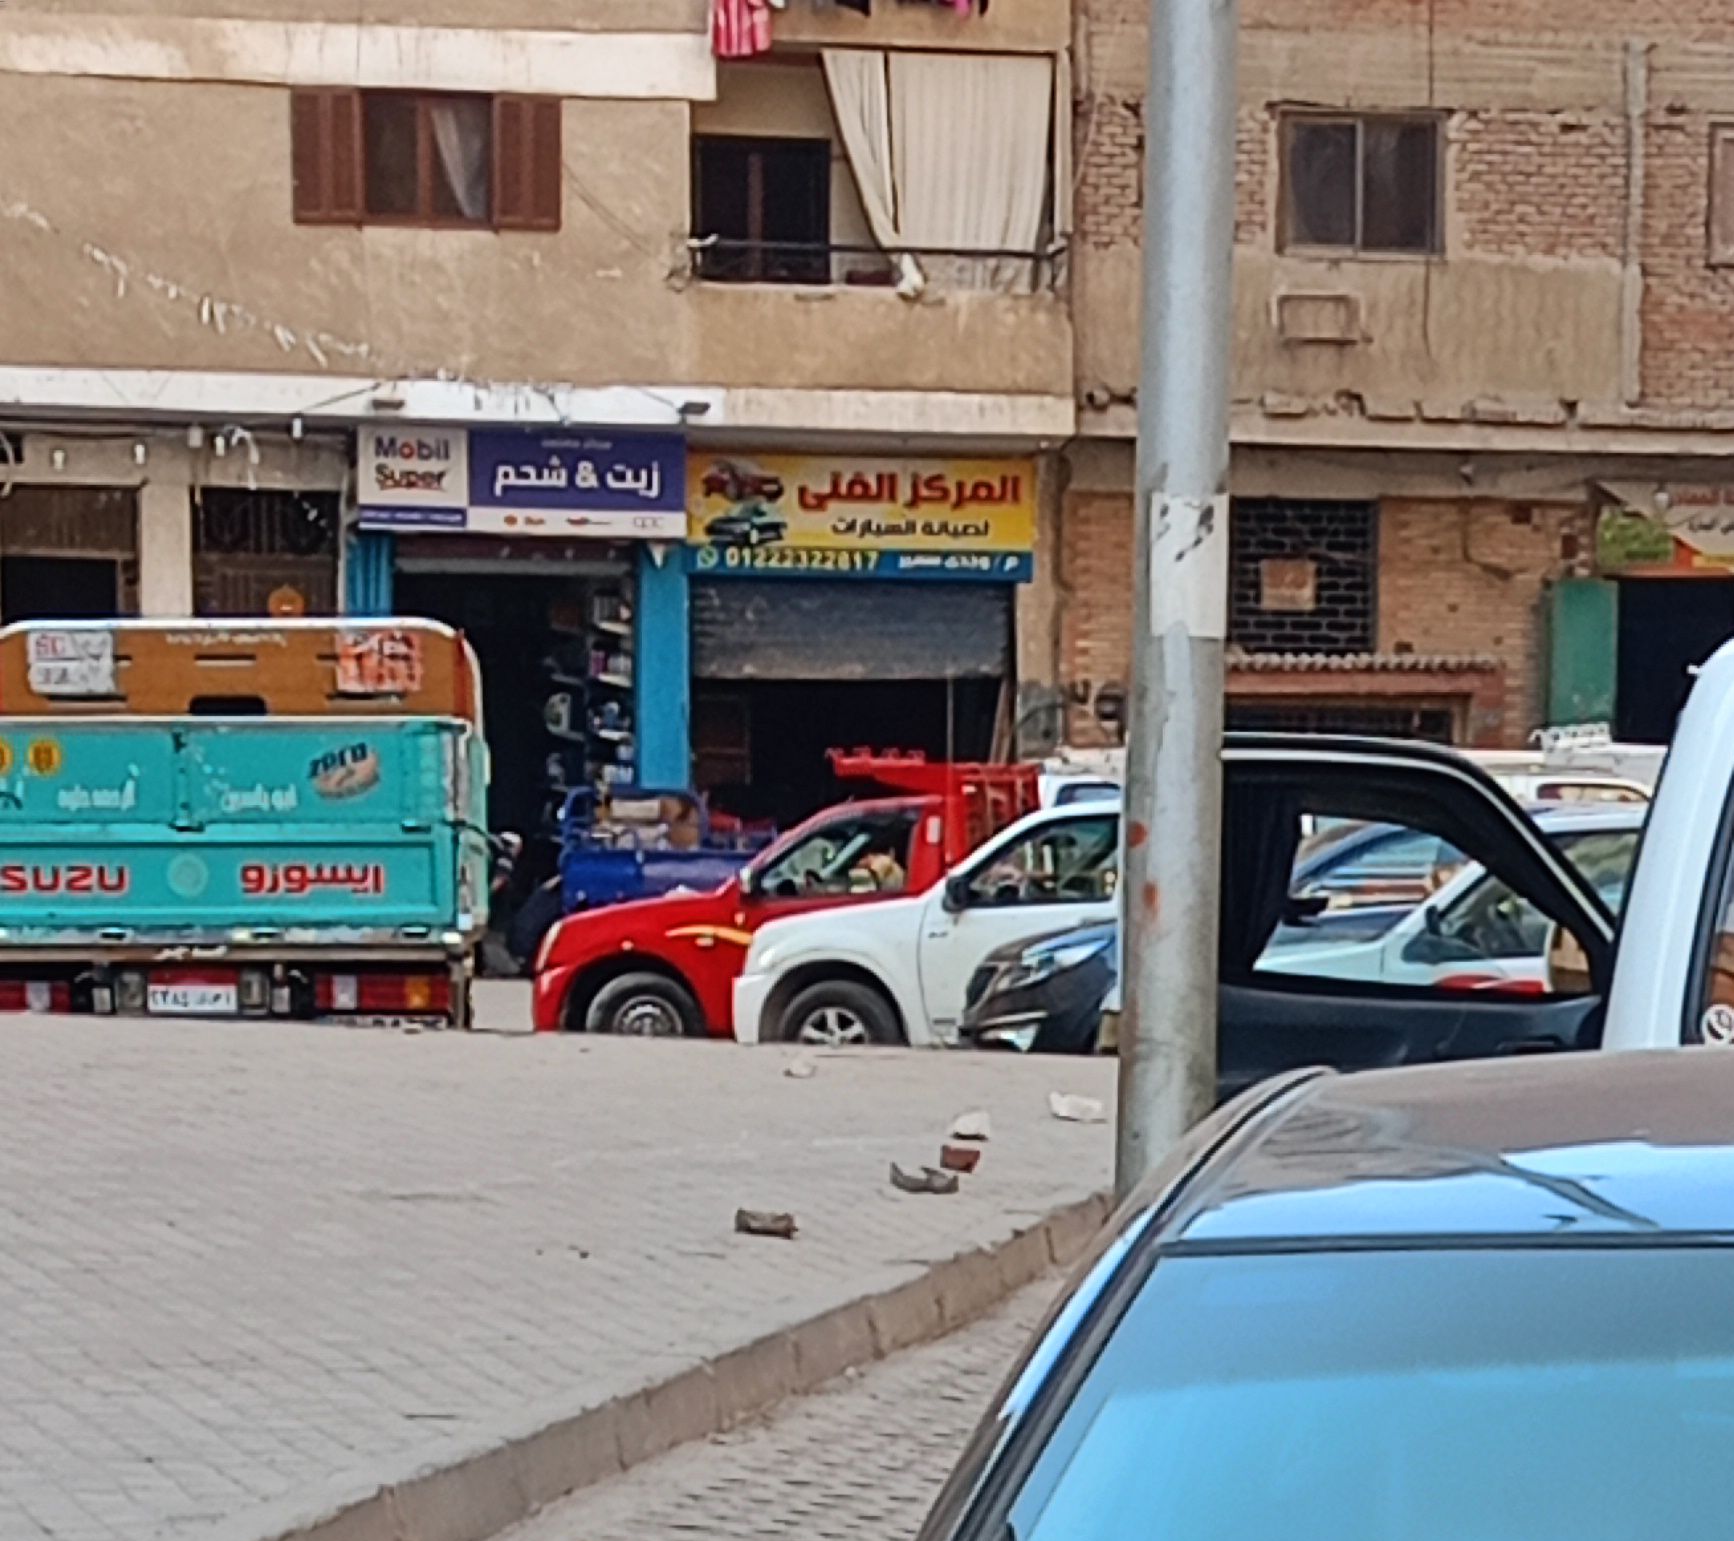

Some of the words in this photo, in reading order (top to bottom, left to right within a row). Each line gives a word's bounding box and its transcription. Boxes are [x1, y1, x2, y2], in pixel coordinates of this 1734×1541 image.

[375, 436, 449, 460] Mobil
[375, 463, 446, 490] Super
[495, 455, 568, 496] شحم
[575, 463, 598, 488] &
[606, 461, 660, 498] زيت
[909, 472, 1022, 508] المركز
[832, 517, 916, 539] السيارات
[0, 866, 126, 892] SUZU
